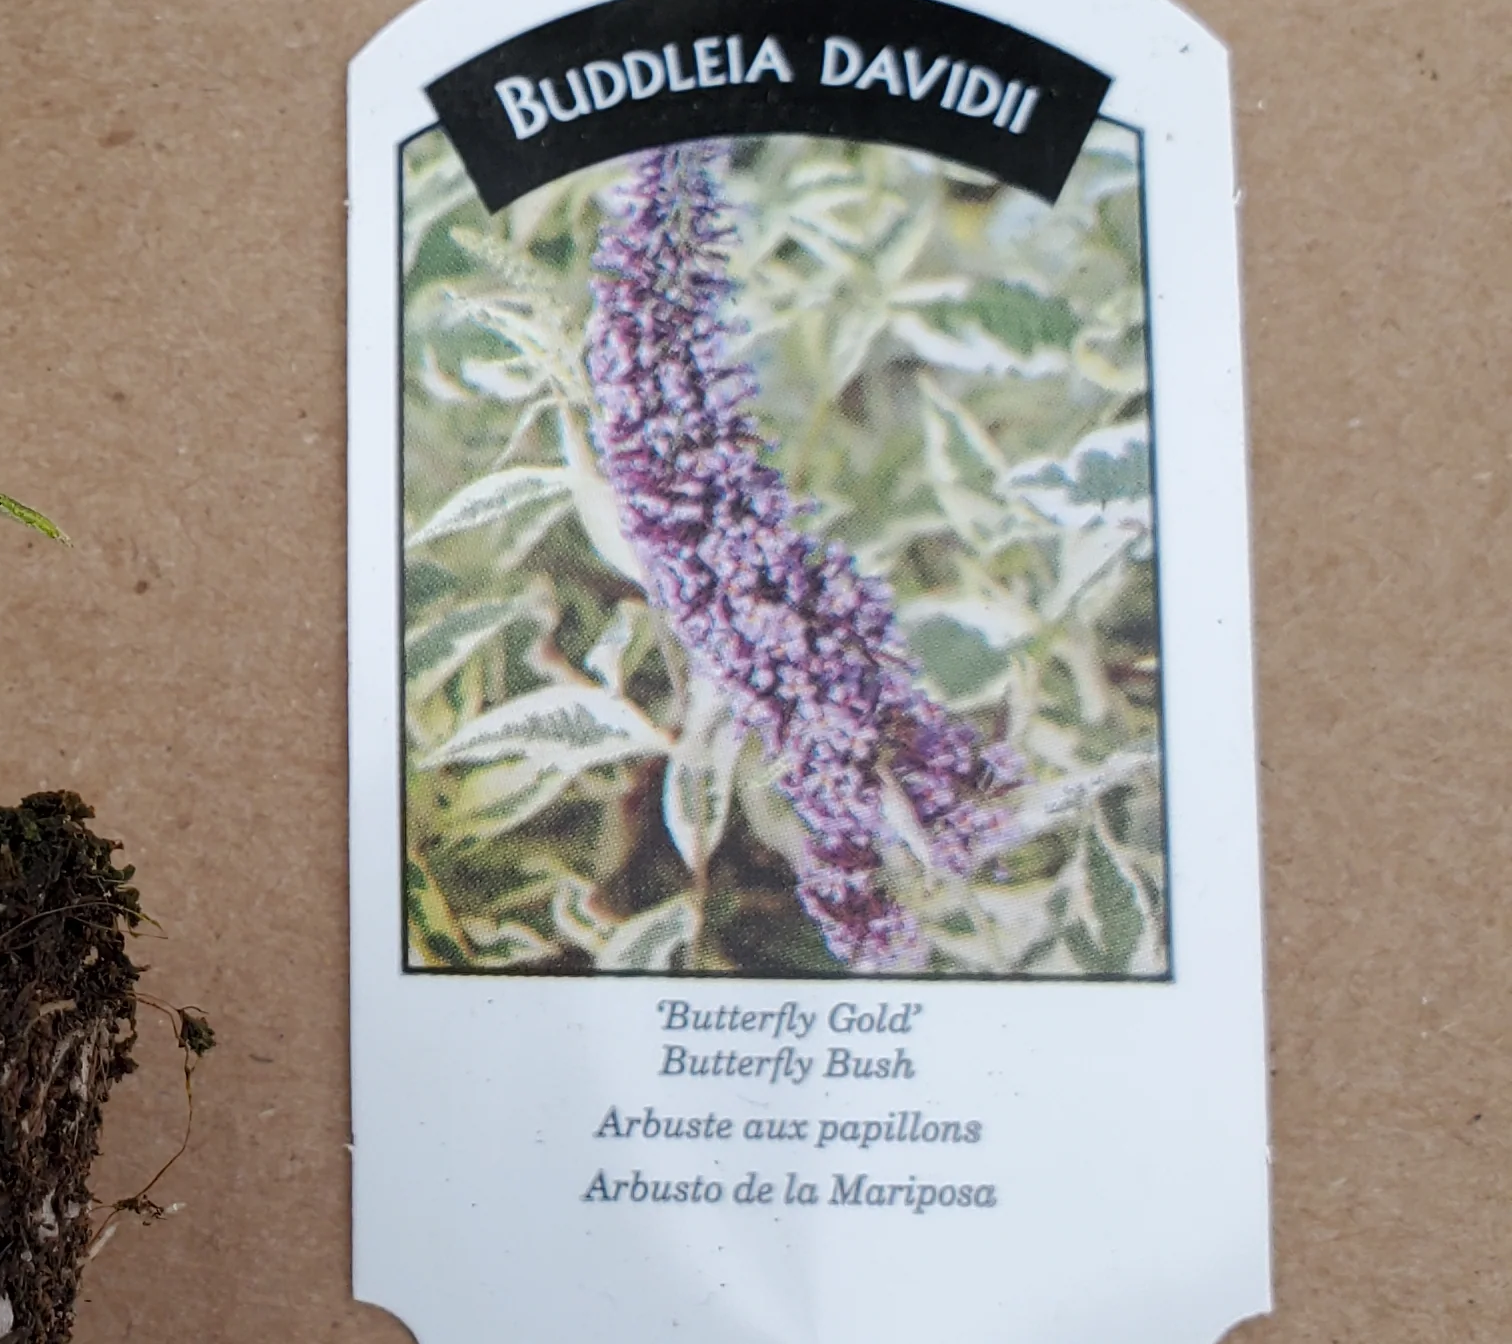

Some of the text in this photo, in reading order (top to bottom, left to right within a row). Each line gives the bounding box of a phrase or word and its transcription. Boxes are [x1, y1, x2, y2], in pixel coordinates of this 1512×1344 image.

[495, 35, 1042, 141] BUDDLEIA DAVIDII
[658, 1045, 916, 1084] Butterfly Bush
[593, 1105, 983, 1148] Arbuste aux papillons
[581, 1169, 998, 1214] Arbusto de la Mariposa
